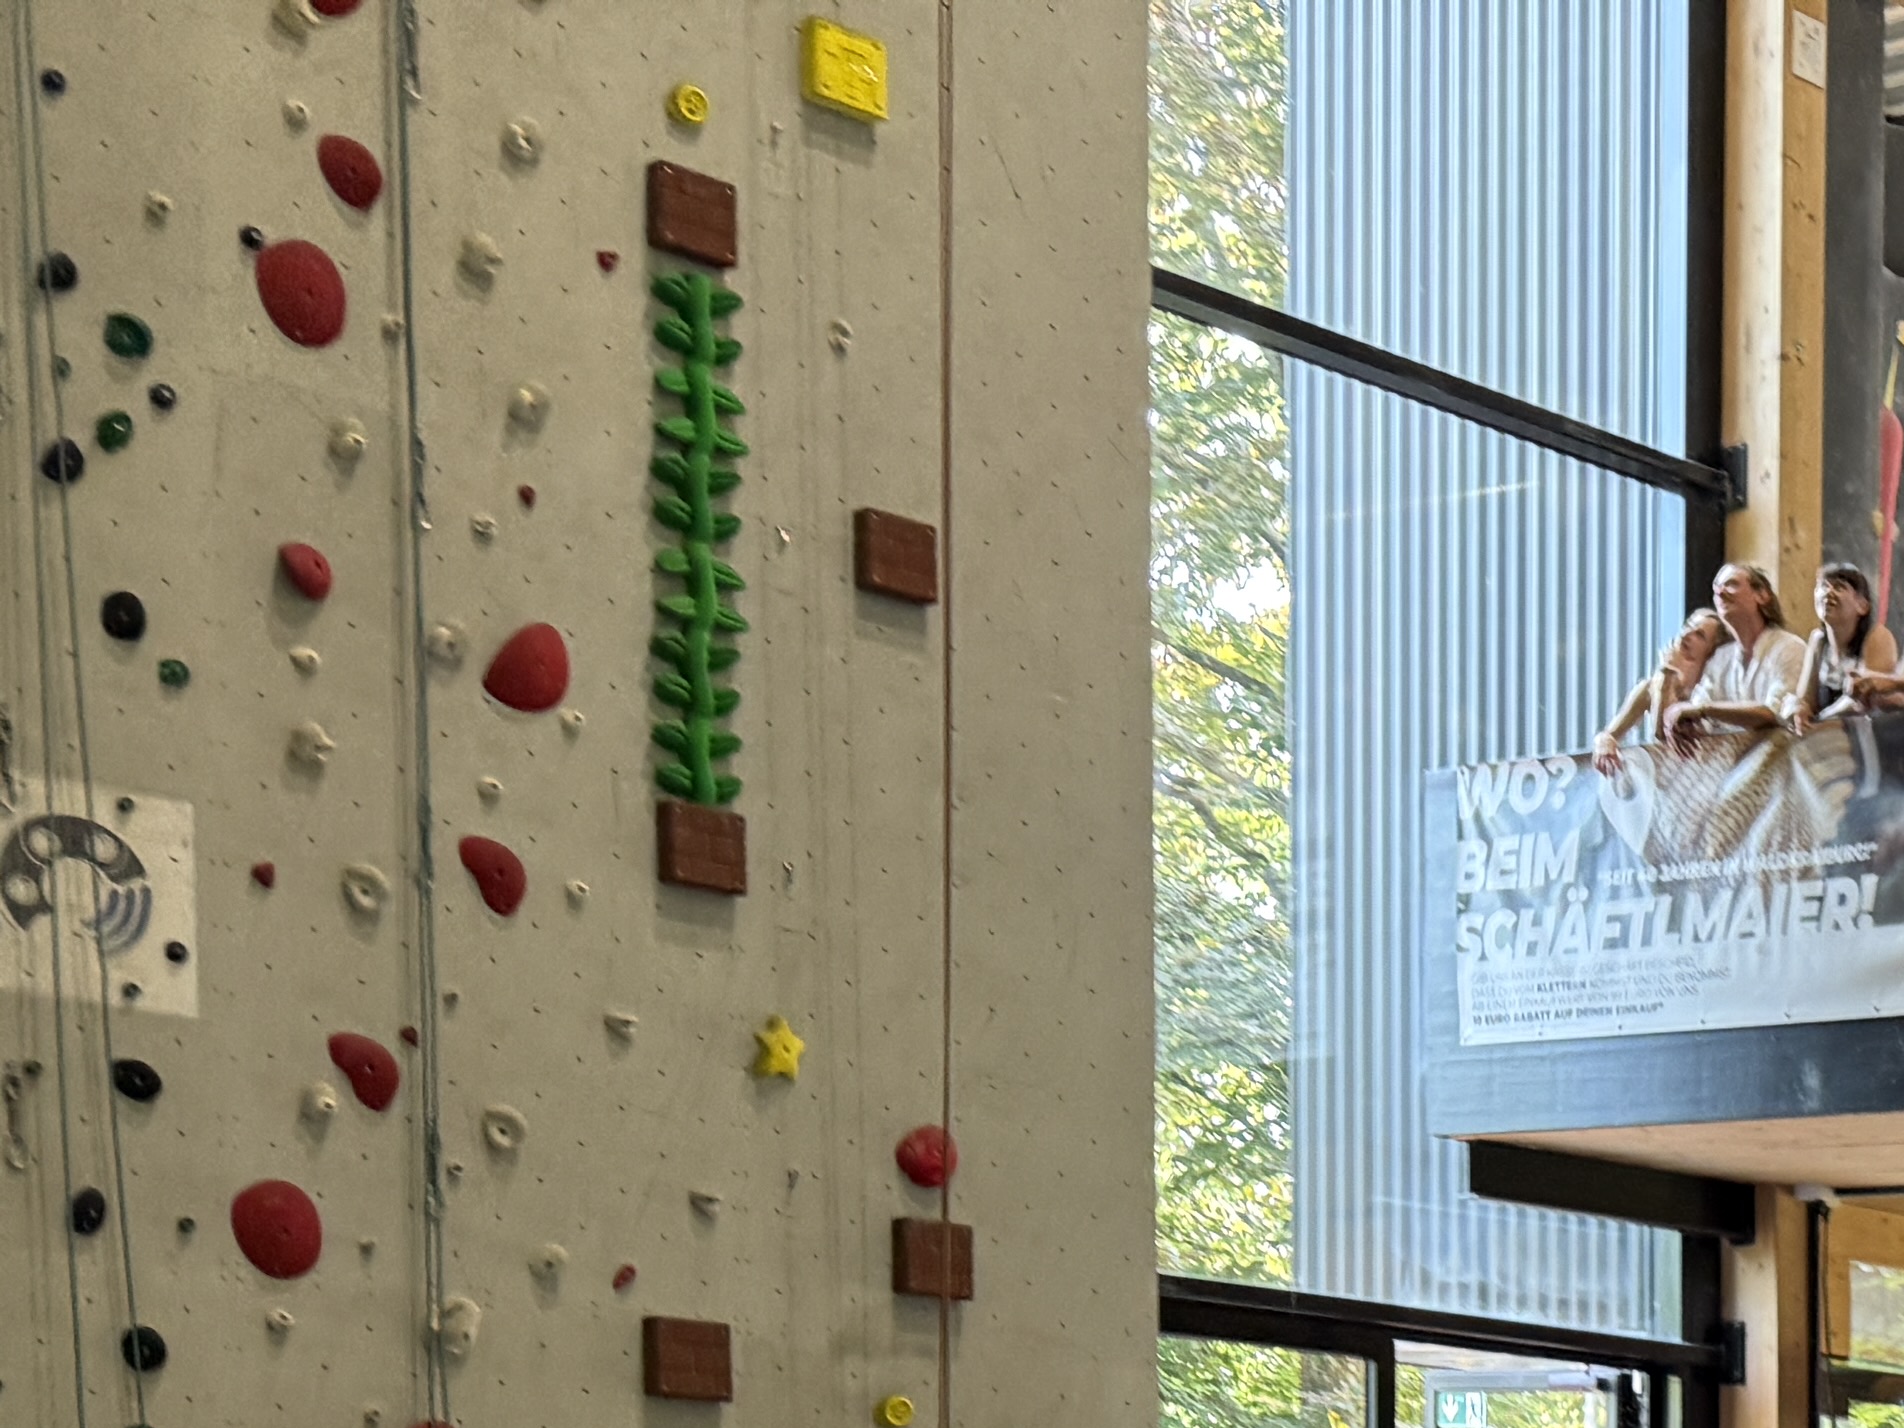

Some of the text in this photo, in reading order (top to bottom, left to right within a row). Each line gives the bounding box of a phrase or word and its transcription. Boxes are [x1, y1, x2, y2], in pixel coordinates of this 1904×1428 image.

[1457, 757, 1579, 820] WO?
[1457, 828, 1580, 895] BEIM
[1456, 874, 1879, 963] SCHÄFTLMAIER!
